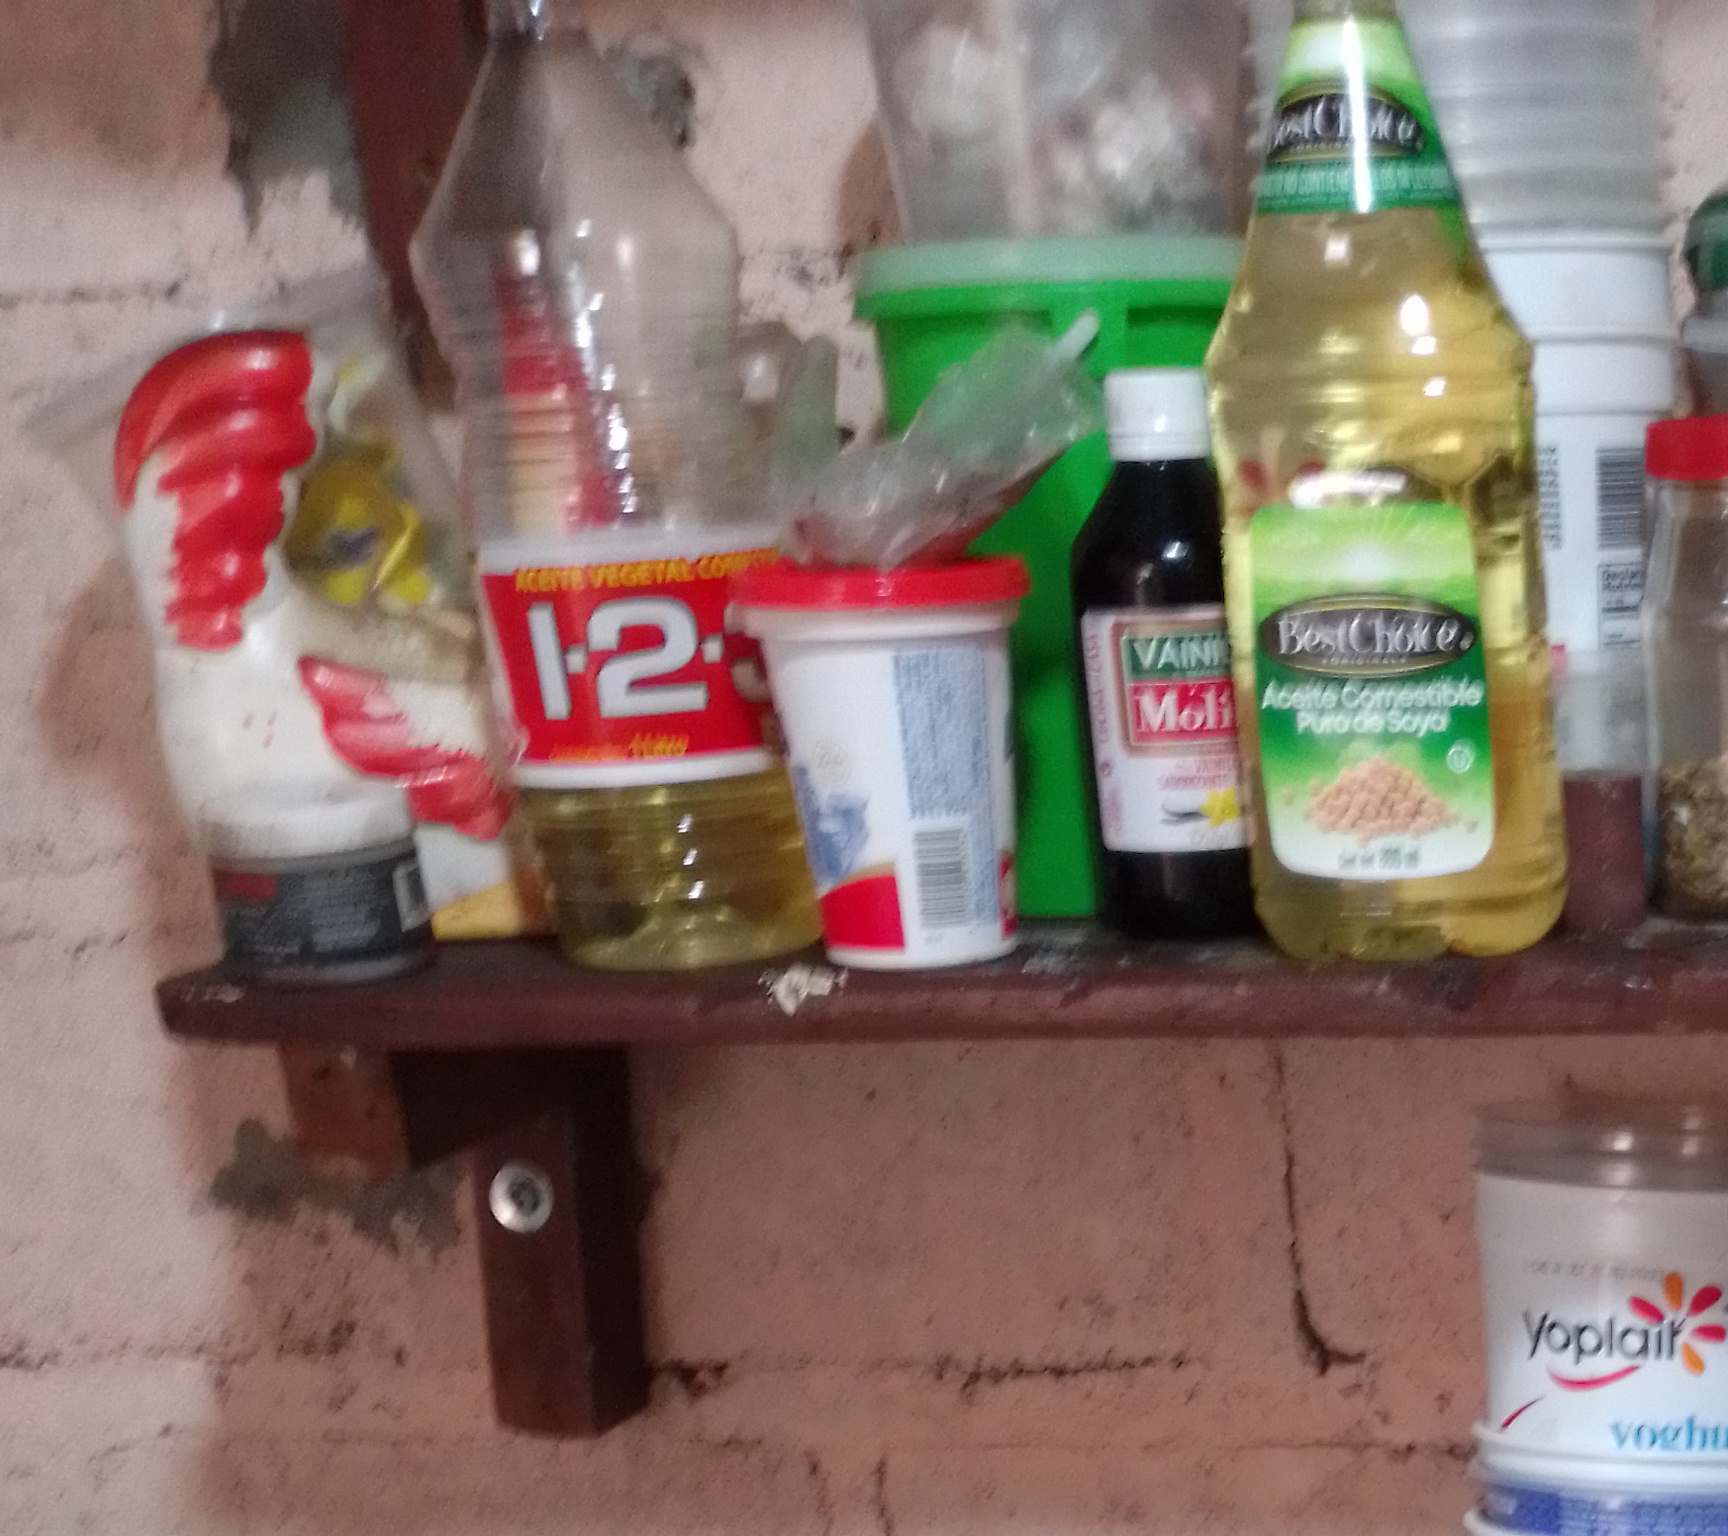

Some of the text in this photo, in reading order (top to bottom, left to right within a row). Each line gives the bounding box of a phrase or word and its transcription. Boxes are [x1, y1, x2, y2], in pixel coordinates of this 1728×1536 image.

[1261, 675, 1485, 709] Aceite Comestible
[1296, 708, 1449, 738] Puro de Soya
